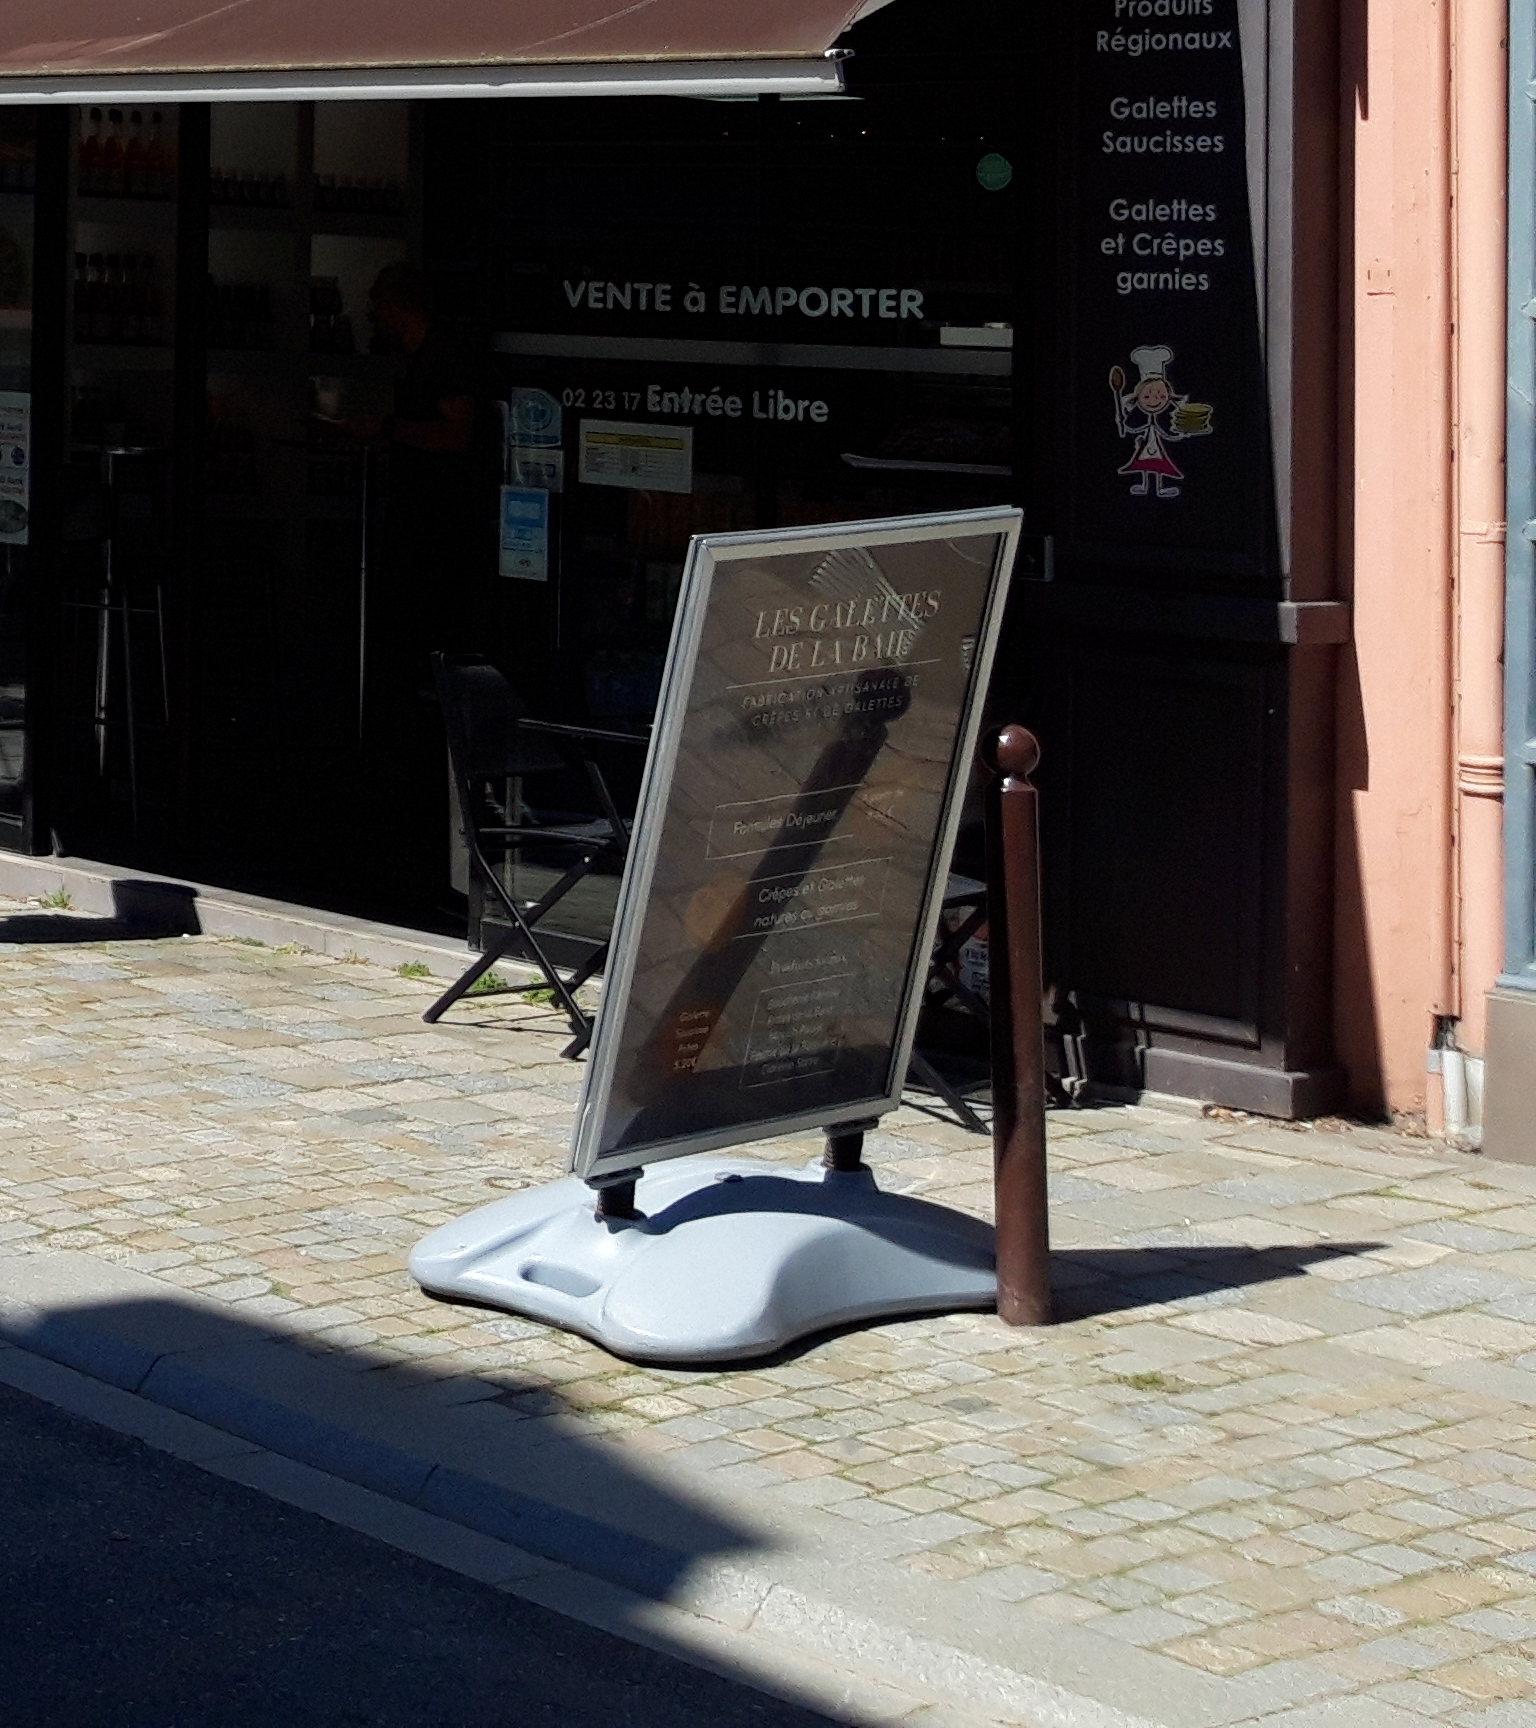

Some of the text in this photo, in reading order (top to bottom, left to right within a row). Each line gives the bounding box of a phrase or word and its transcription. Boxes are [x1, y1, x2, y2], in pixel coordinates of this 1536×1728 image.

[1096, 26, 1233, 57] Régionaux
[1109, 95, 1218, 120] Galettes
[1101, 130, 1226, 154] Saucisses
[1109, 198, 1217, 222] Galettes
[1100, 232, 1226, 262] et Crêpes
[1116, 267, 1210, 295] garnies
[563, 279, 924, 320] VENTE à EMPORTER
[562, 387, 643, 411] 02 23 17
[647, 385, 829, 422] Entrée Libre
[753, 589, 943, 640] LES GALETTES
[769, 627, 915, 673] DE LA BAIE
